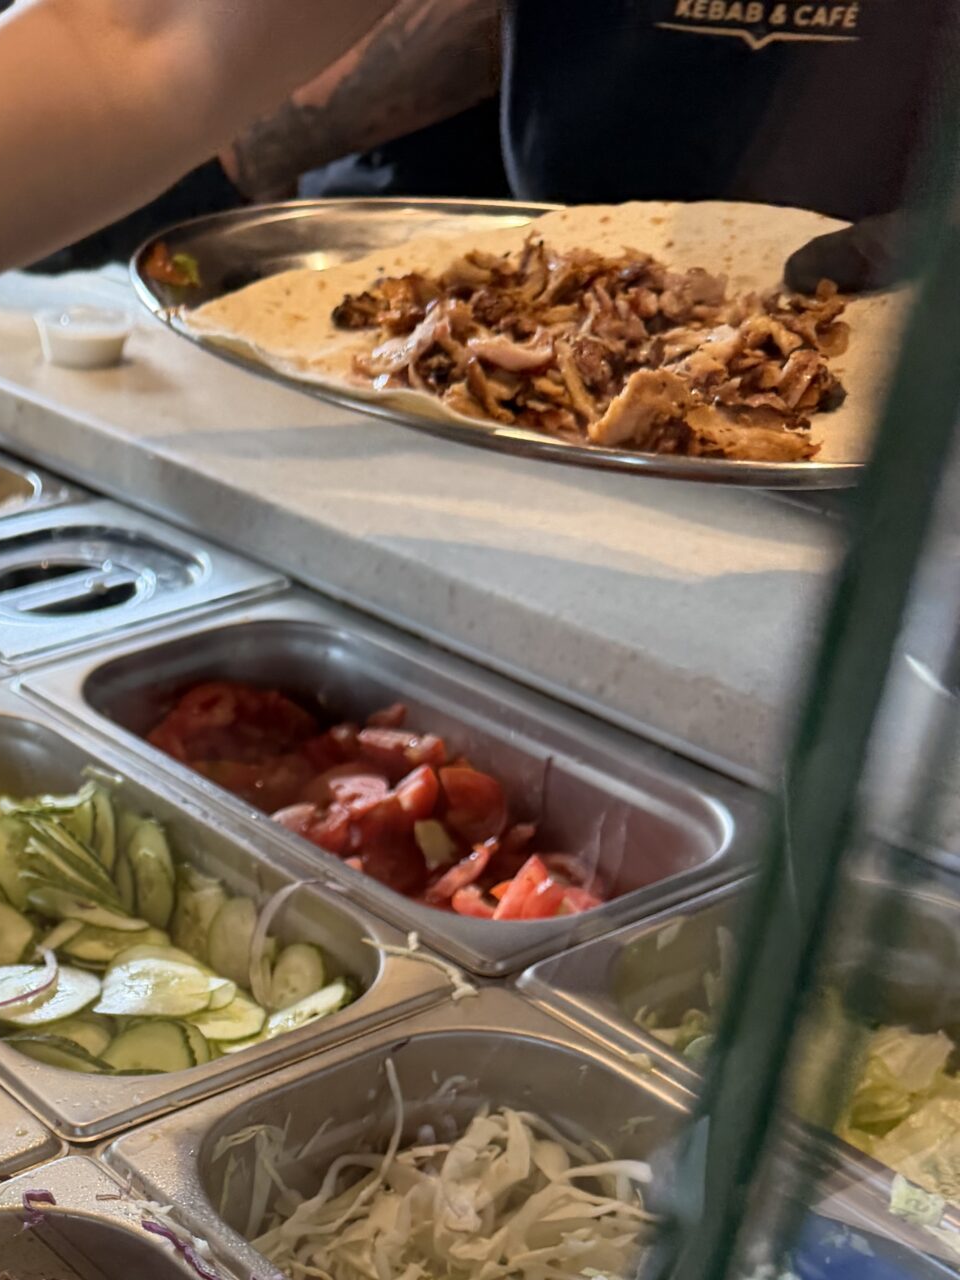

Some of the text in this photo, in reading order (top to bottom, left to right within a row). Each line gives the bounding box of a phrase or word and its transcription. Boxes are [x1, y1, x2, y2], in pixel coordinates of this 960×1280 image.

[675, 0, 859, 28] KEBAB & CAFÉ
